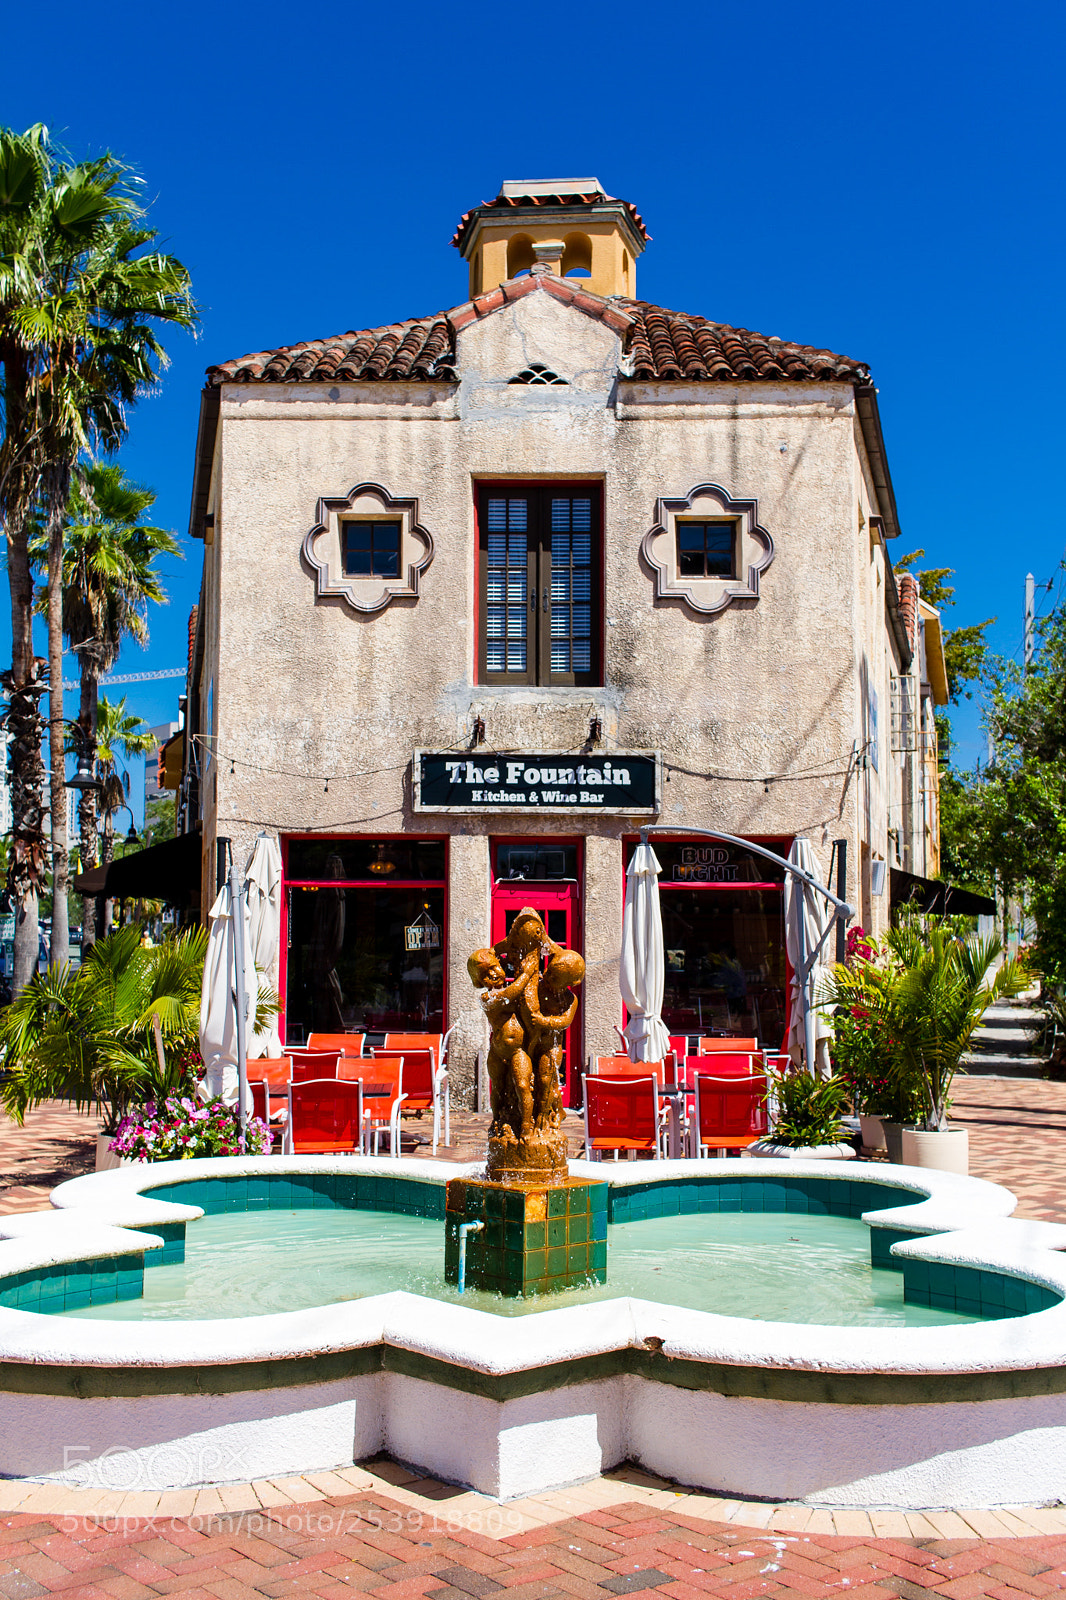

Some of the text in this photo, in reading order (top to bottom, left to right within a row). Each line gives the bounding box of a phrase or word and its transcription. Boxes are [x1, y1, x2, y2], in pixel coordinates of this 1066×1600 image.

[445, 761, 632, 785] The Fountain
[471, 790, 604, 804] Kitchen & Wine Bar
[681, 848, 729, 865] BUD
[672, 864, 739, 881] LIGHT
[407, 931, 439, 945] OPEN
